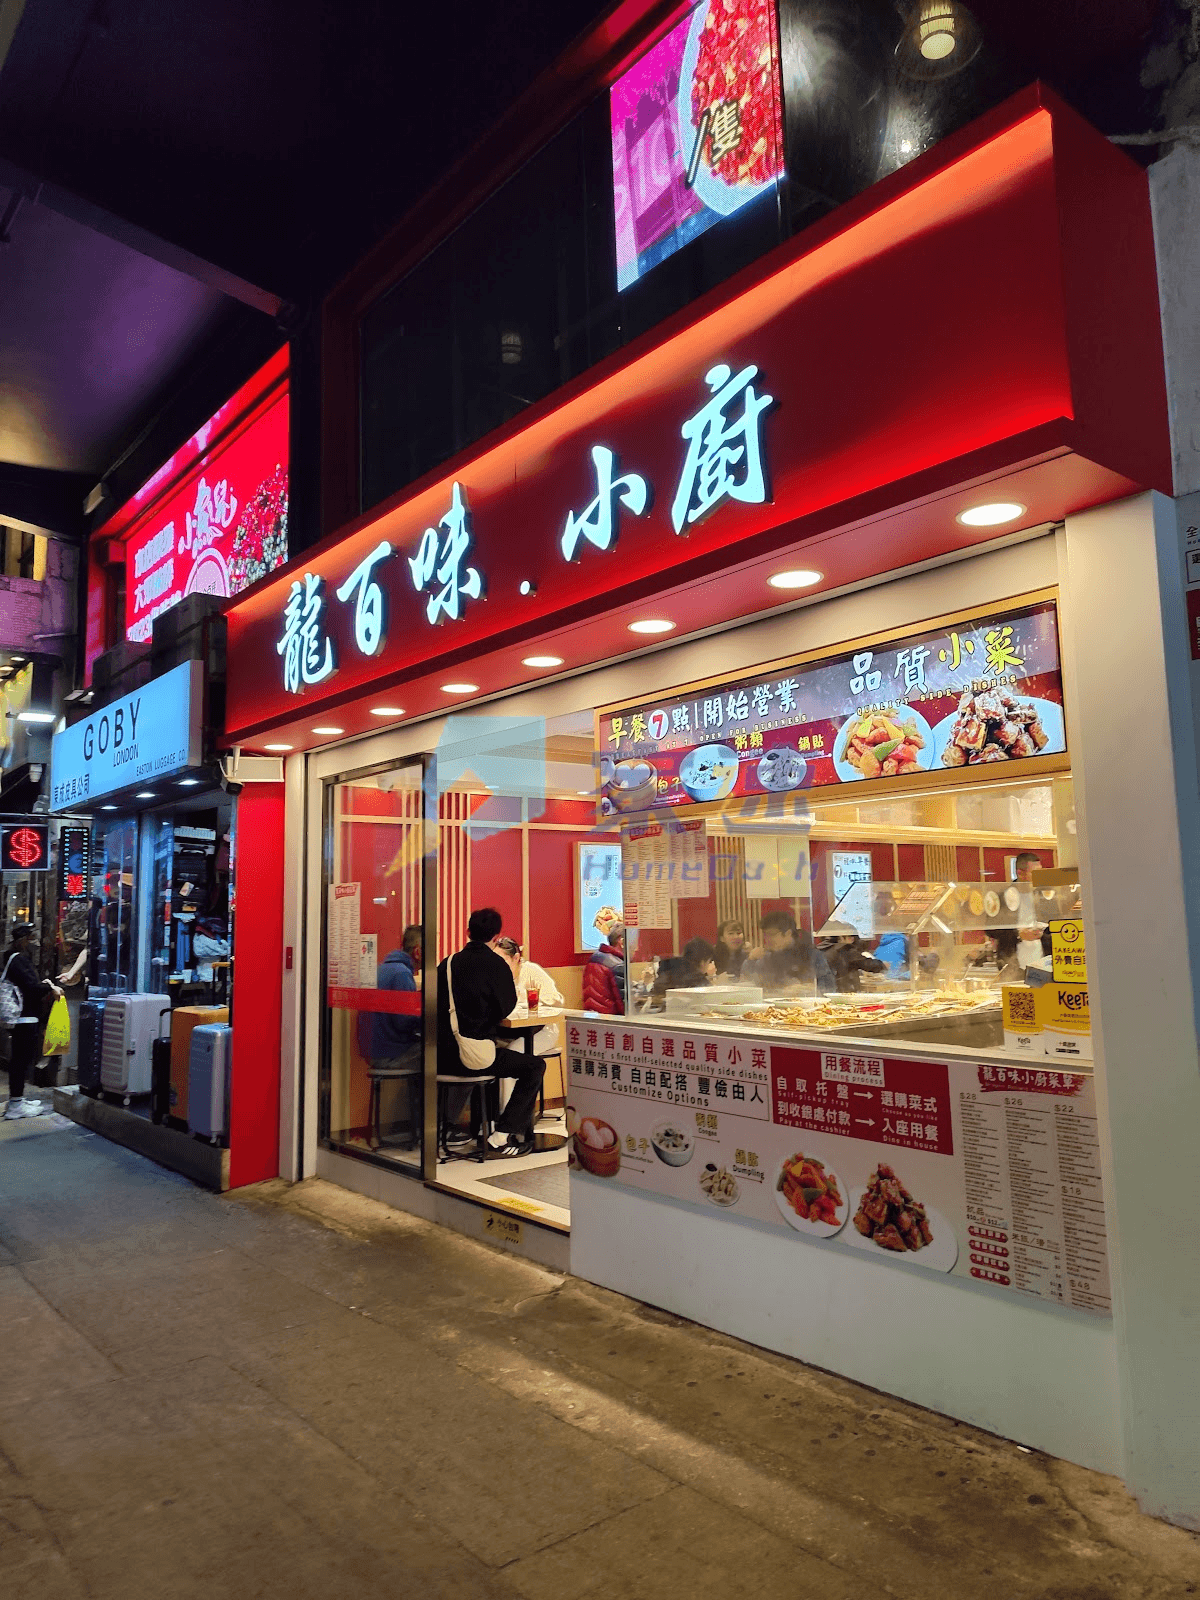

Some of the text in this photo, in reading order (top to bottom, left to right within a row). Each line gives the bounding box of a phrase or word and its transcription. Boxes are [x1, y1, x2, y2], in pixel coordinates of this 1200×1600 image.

[849, 626, 1025, 695] 品質小菜
[856, 674, 1017, 716] QUALITY SIDE DISHES
[83, 697, 142, 761] GOBY
[699, 732, 722, 742] OPEN
[729, 726, 746, 737] FOR
[754, 713, 808, 731] BUSINESS
[734, 731, 764, 750] 粥類
[797, 733, 824, 752] 鍋貼
[113, 743, 139, 768] LONDON
[154, 752, 176, 771] LUGGAGE
[736, 748, 764, 758] Congee
[657, 776, 682, 795] 包子
[569, 1027, 767, 1070] 全港首創自選品質小菜
[570, 1047, 587, 1057] Hong
[616, 1052, 632, 1063] first
[633, 1055, 683, 1069] self-selected
[685, 1062, 716, 1076] quality
[718, 1065, 736, 1077] side
[739, 1069, 768, 1081] dishes
[825, 1055, 882, 1077] 用餐流程
[571, 1058, 764, 1104] 選購消費 自由配搭 豐儉由人
[776, 1076, 849, 1100] 自取托盤
[824, 1071, 883, 1086] Dining process
[982, 1066, 1075, 1089] 龍百味小廚菜單
[611, 1081, 709, 1107] Customize Options
[777, 1090, 849, 1108] Self-pickup tray
[880, 1090, 938, 1114] 選購菜式
[959, 1092, 977, 1101] $28
[777, 1100, 850, 1127] 到收銀處付款
[881, 1107, 903, 1116] Choose
[1054, 1104, 1074, 1113] $22
[779, 1116, 792, 1127] Pay
[805, 1121, 818, 1130] the
[820, 1125, 850, 1136] cashier
[882, 1117, 939, 1142] 入座用餐
[903, 1138, 911, 1146] in
[913, 1140, 939, 1151] house
[732, 1164, 765, 1181] Dumpling
[1061, 1185, 1082, 1196] $18
